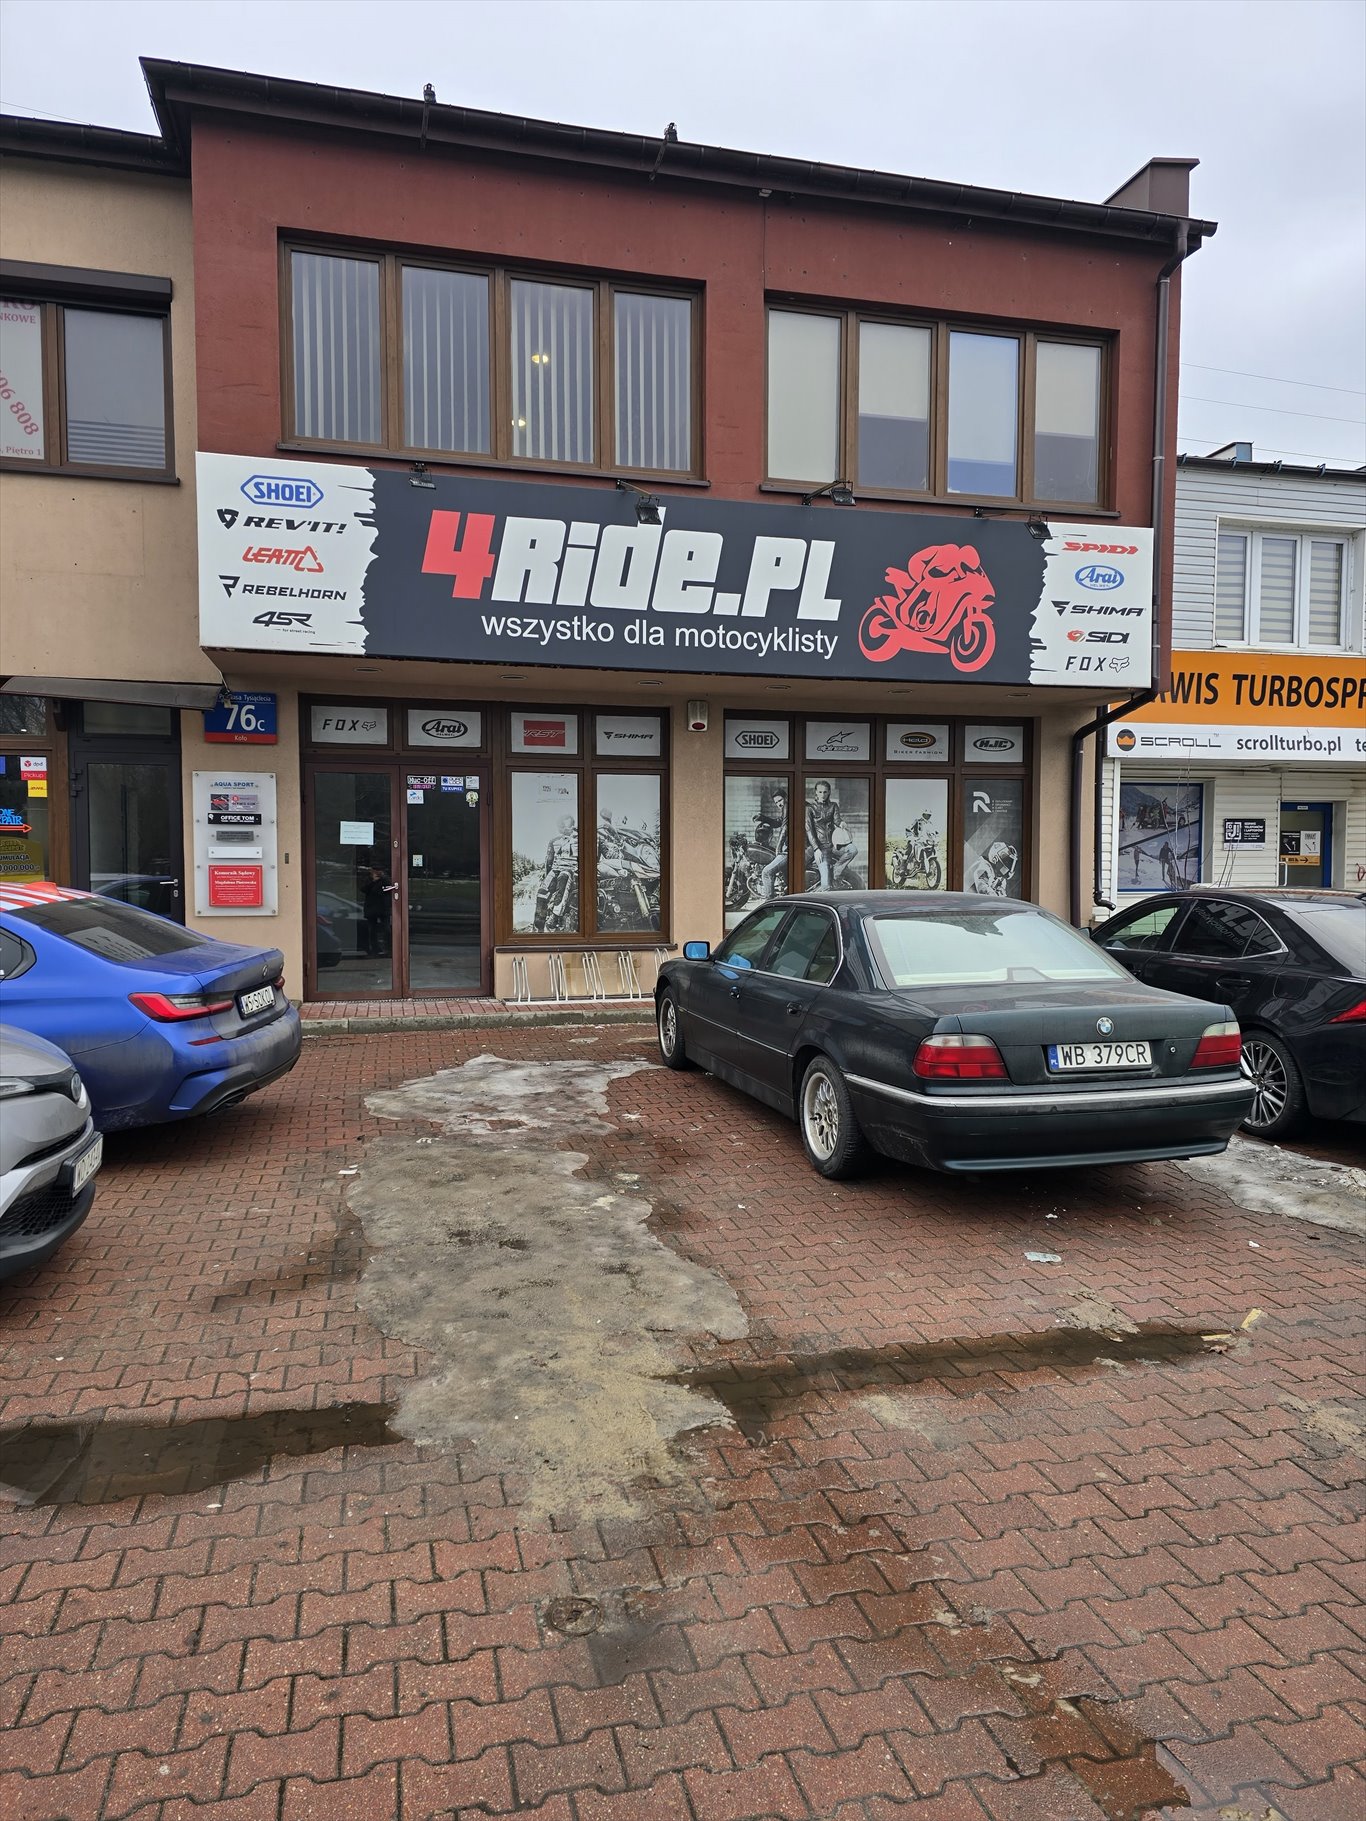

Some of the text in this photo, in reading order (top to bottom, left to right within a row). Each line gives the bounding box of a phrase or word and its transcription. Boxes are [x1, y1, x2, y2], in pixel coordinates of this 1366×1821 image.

[10, 402, 39, 435] 808
[254, 481, 311, 503] SHOEI
[1062, 541, 1139, 555] SPIDI
[1079, 567, 1119, 584] Arai
[242, 584, 347, 601] REBELHORN
[1070, 604, 1145, 617] SHIMA
[252, 610, 313, 628] 4SR
[481, 614, 839, 660] wszystko dla motocyklisty
[1065, 656, 1107, 672] FOX
[1153, 672, 1219, 704] WIS
[322, 718, 360, 731] FOX
[425, 720, 463, 734] Arai
[524, 729, 564, 738] RST
[742, 734, 774, 746] SHOEI
[979, 740, 1008, 748] HJC
[1140, 736, 1221, 748] SCROLL
[1237, 734, 1341, 755] scrollturbo.pl
[1061, 1043, 1148, 1067] WB 379CR
